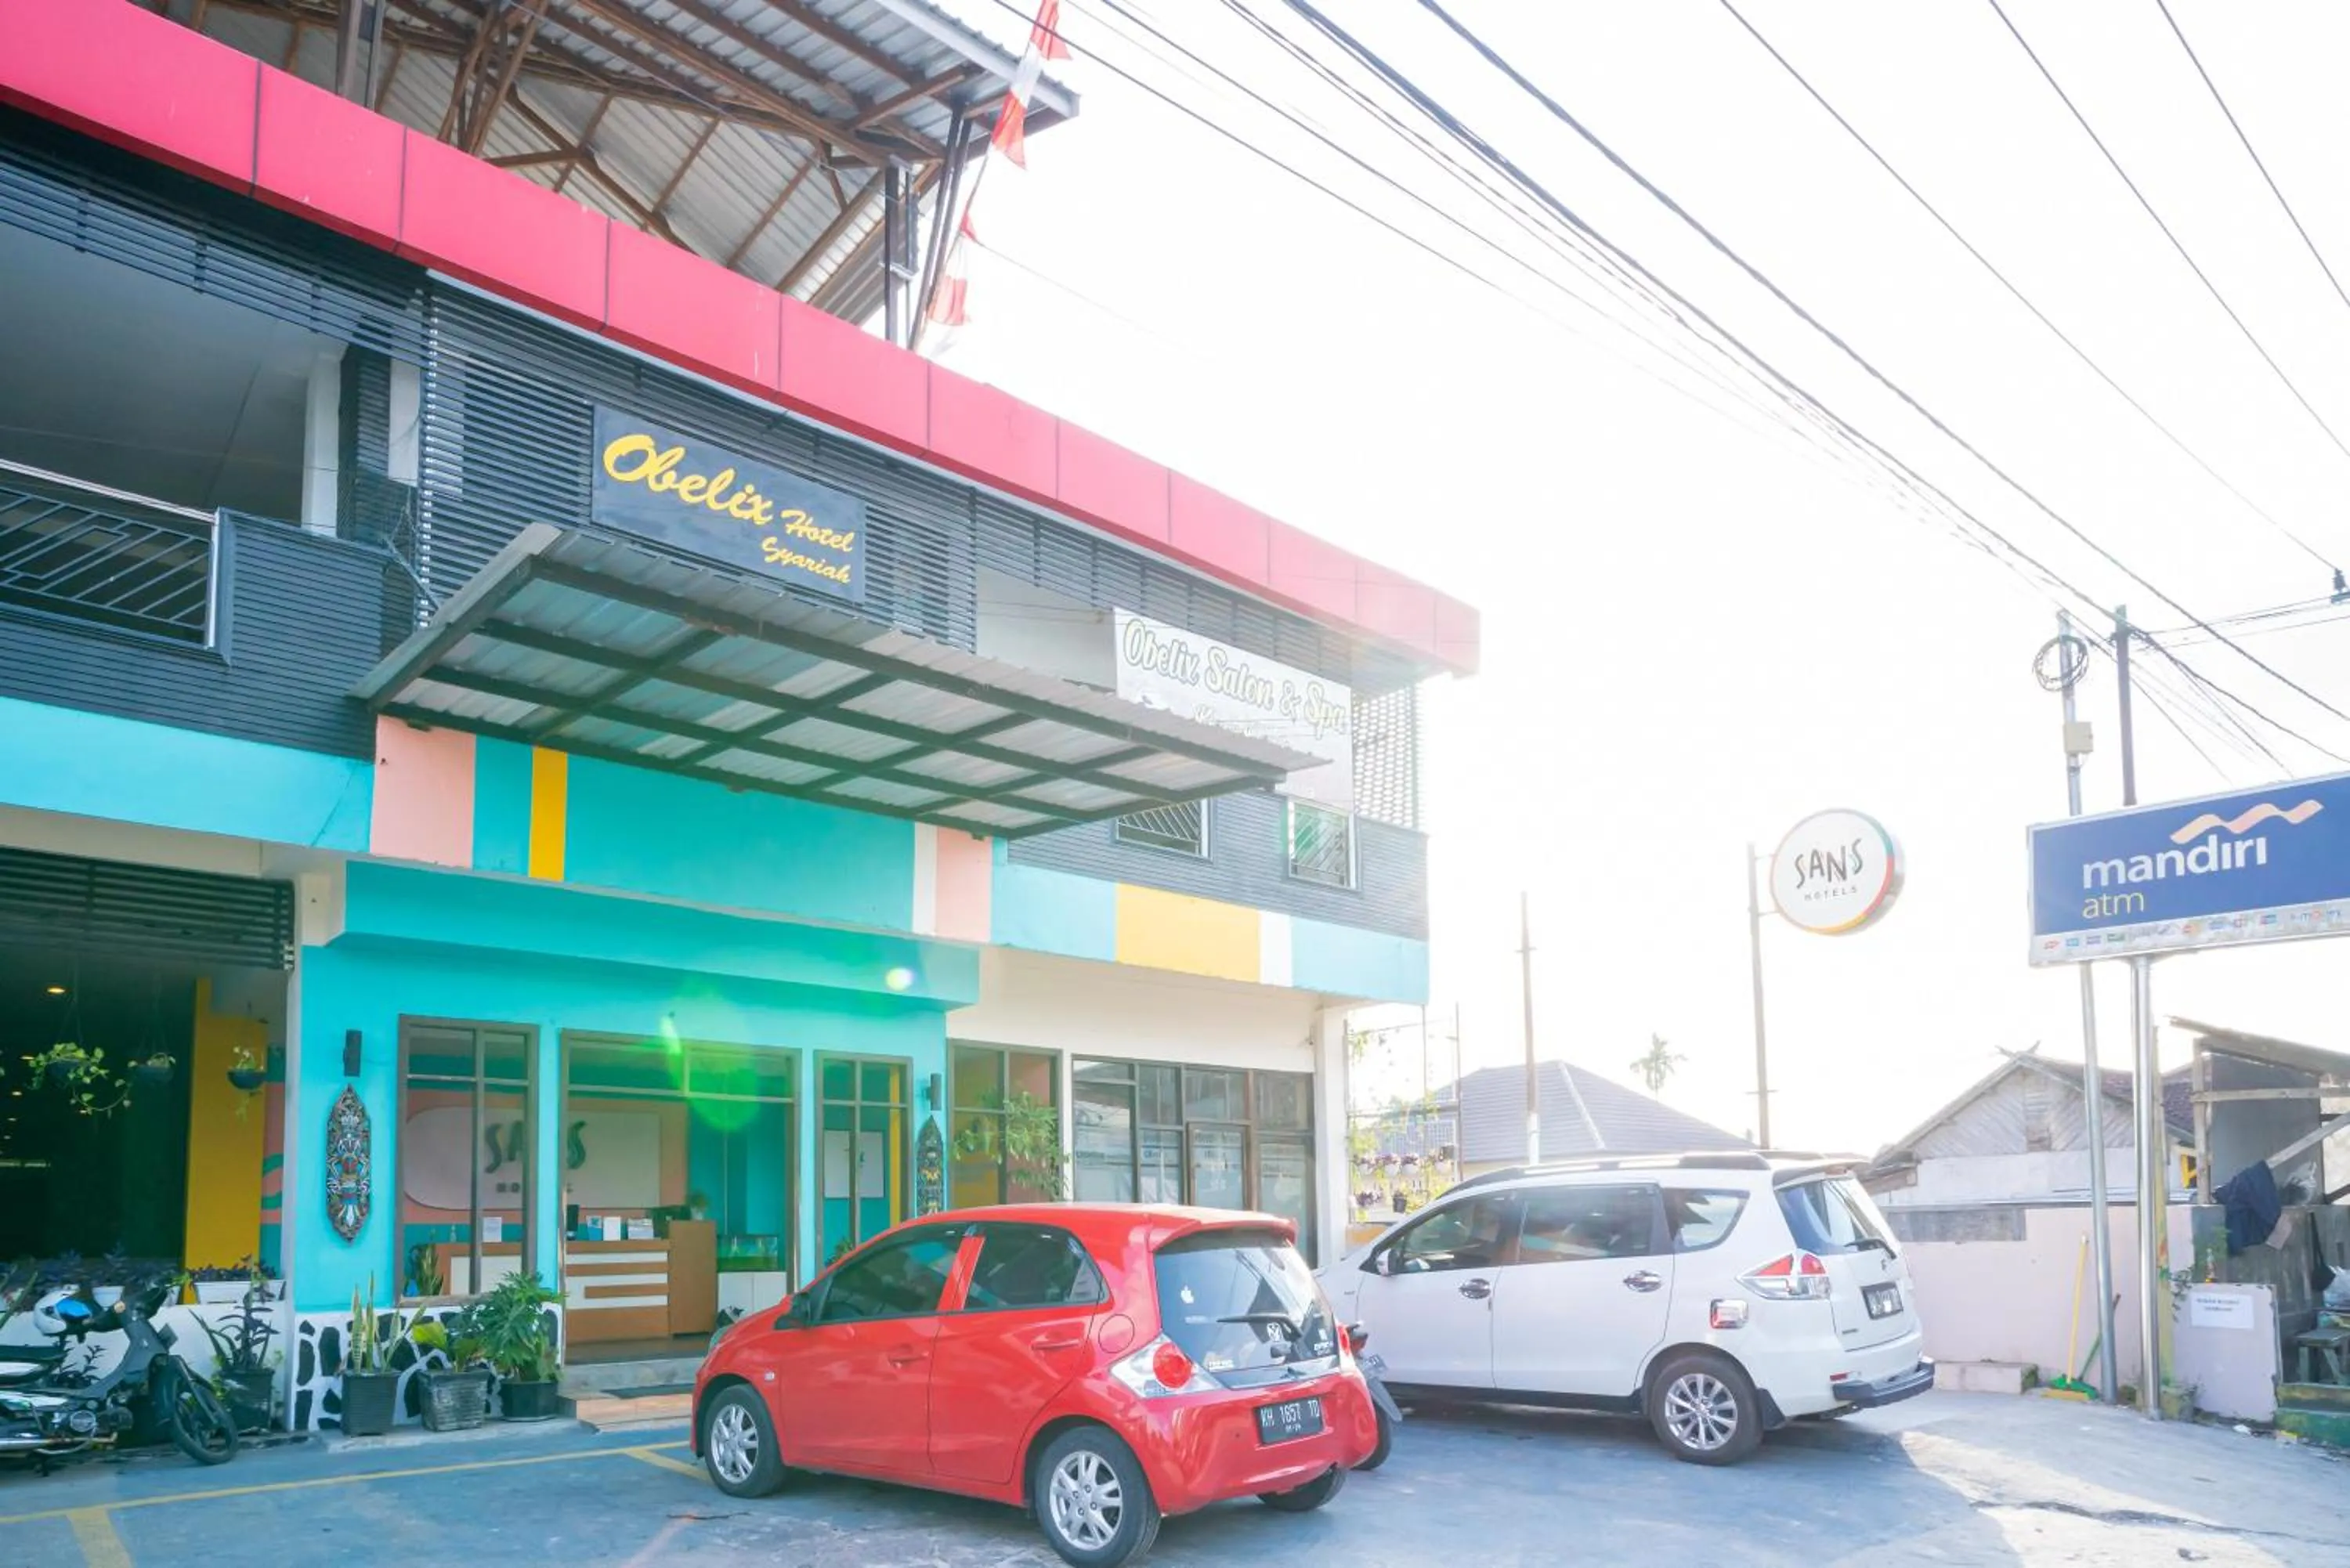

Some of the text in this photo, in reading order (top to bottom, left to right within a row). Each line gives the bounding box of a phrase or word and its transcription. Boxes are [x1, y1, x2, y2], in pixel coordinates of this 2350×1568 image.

[602, 433, 855, 553] Obelix Hotel
[761, 537, 851, 584] Syariah
[1123, 617, 1201, 687] Obelix
[1204, 645, 1274, 710] Salon
[1278, 679, 1303, 717] &
[1303, 681, 1347, 740] Spa
[1794, 838, 1864, 889] SANS
[2082, 834, 2267, 889] mandiri
[1803, 886, 1857, 901] HOTELS
[2082, 888, 2145, 919] atm
[1260, 1407, 1274, 1427] KH
[1279, 1403, 1302, 1424] 1657
